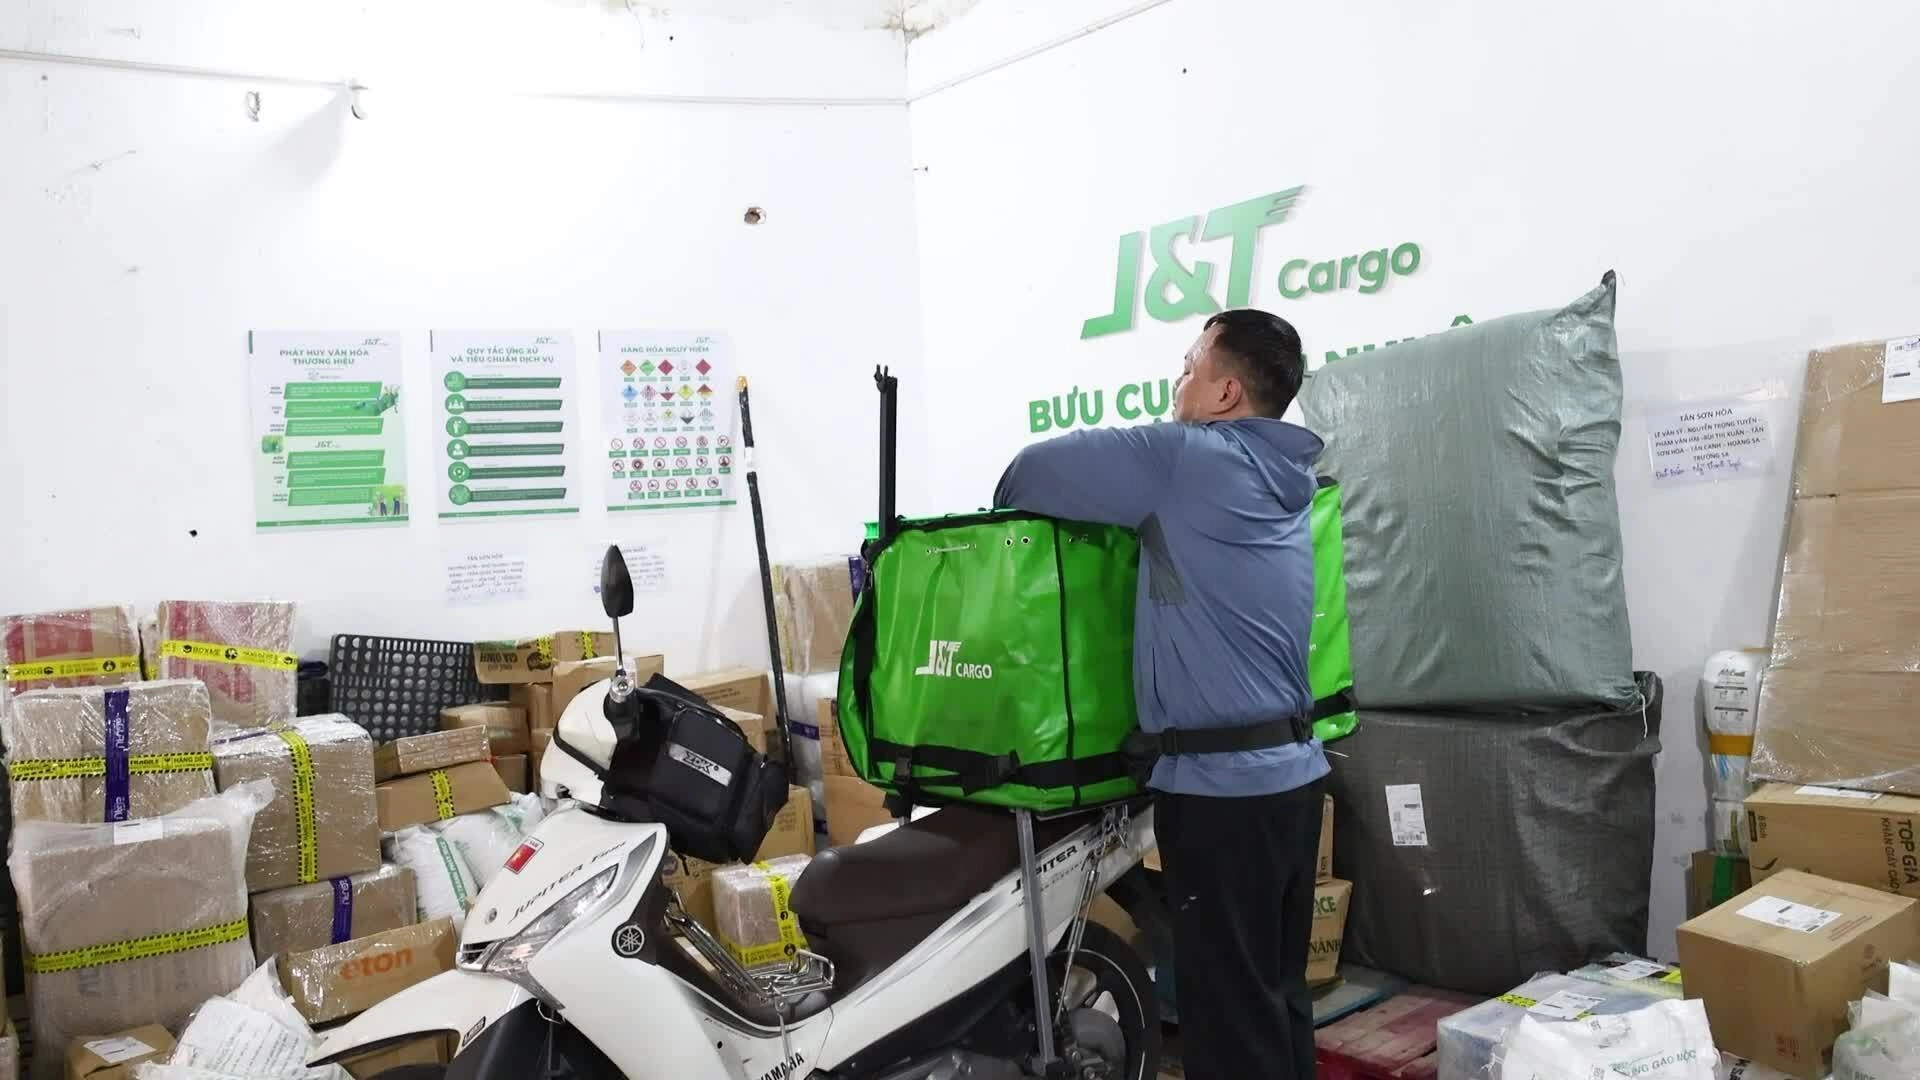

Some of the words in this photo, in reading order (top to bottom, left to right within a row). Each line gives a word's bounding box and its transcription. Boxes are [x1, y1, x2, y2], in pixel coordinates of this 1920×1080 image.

[1080, 184, 1310, 339] J&T
[1278, 242, 1422, 301] Cargo
[280, 348, 304, 357] PHÁT
[306, 348, 325, 357] HUY
[466, 346, 486, 355] QUY
[1029, 385, 1104, 433] BƯU
[1116, 378, 1174, 424] CỤ
[1680, 413, 1695, 423] TÂN
[1697, 410, 1714, 420] SƠN
[915, 639, 961, 678] J&T
[955, 663, 992, 679] CARGO
[1897, 818, 1916, 852] TOP
[338, 948, 415, 980] eton
